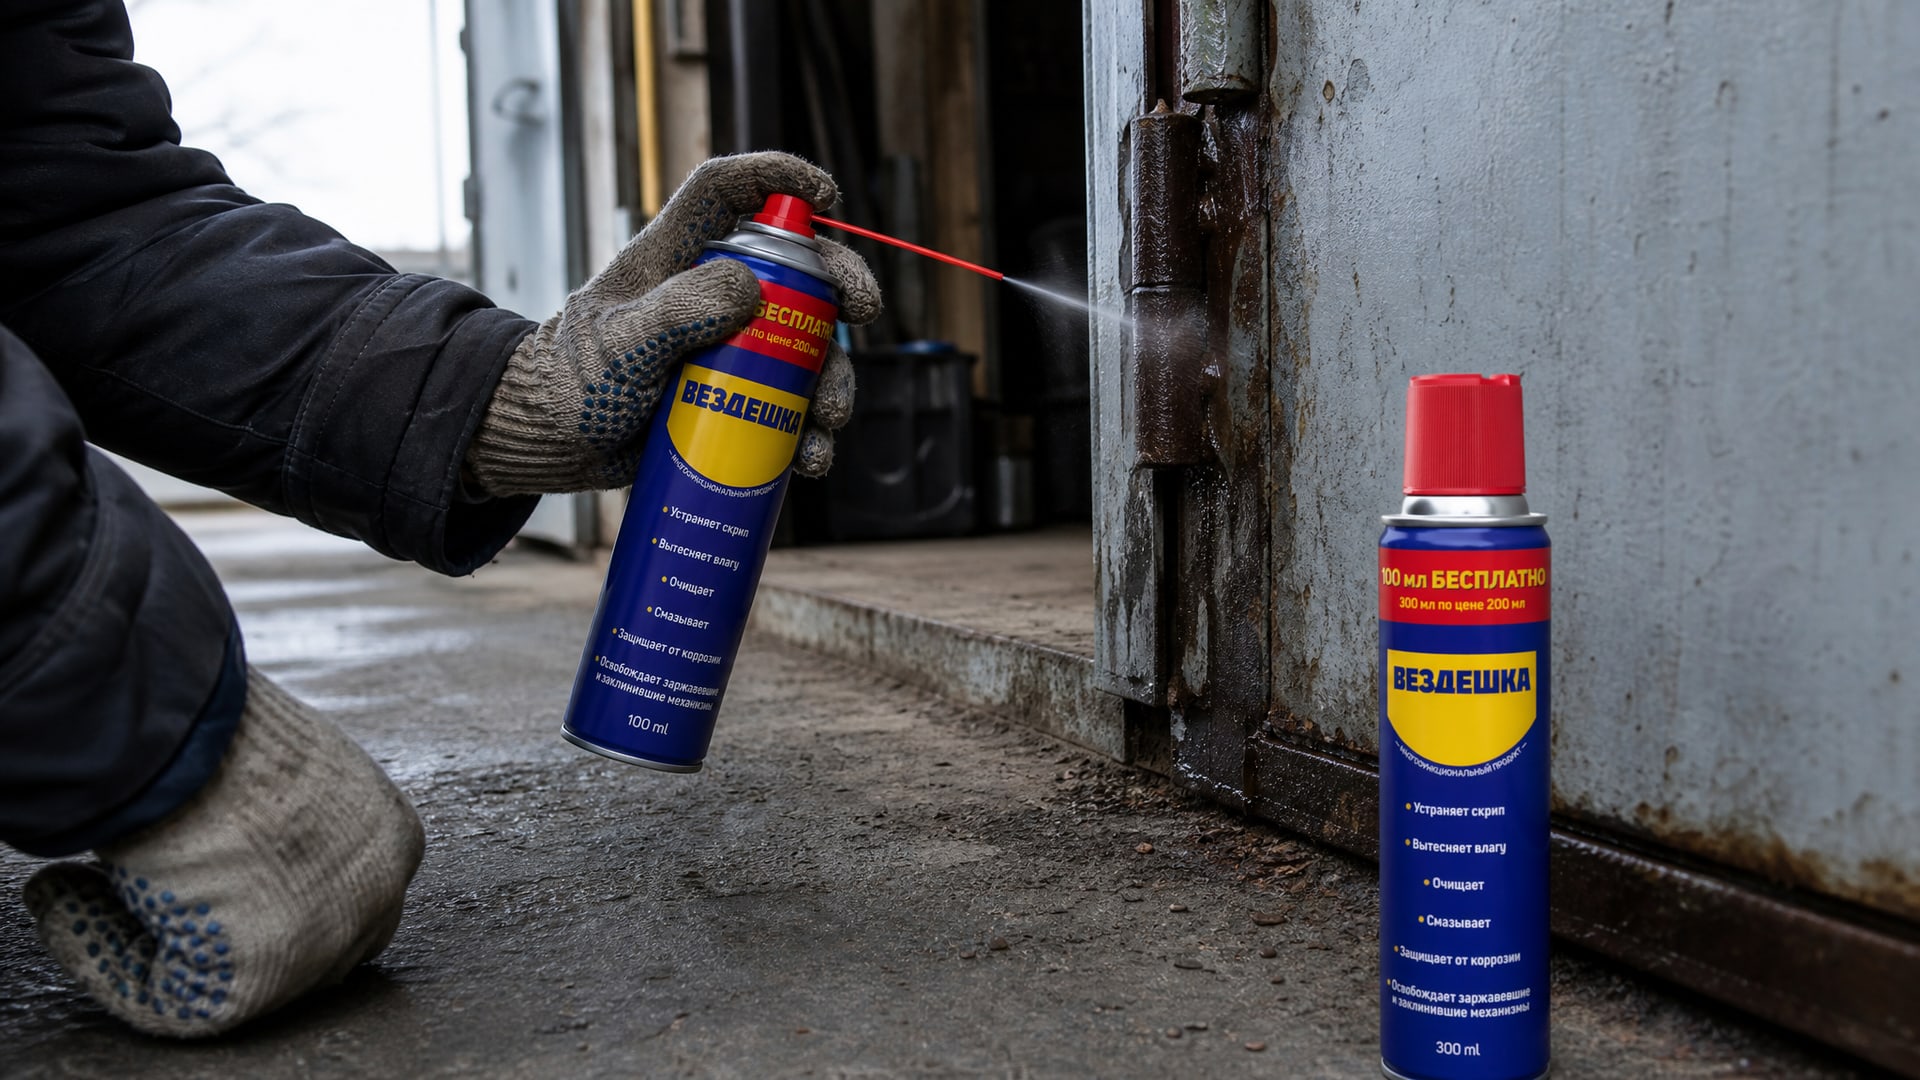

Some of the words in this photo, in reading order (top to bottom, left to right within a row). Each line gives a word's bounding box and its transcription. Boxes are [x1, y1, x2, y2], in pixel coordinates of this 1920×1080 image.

[751, 328, 765, 339] по
[766, 332, 792, 348] цене
[793, 338, 810, 354] 200
[681, 380, 802, 435] ВЕЗДЕШКА
[670, 506, 721, 530] Устраняет
[722, 524, 749, 538] скрип
[658, 538, 712, 562] Вытесняет
[713, 556, 740, 572] влагу
[669, 576, 715, 598] Очищает
[1382, 567, 1401, 587] 100
[1403, 573, 1427, 588] мл
[1431, 567, 1546, 590] БЕСПЛАТНО
[1399, 596, 1418, 609] 300
[1420, 599, 1436, 610] мл
[1438, 600, 1453, 610] по
[1455, 600, 1485, 612] цене
[1486, 598, 1510, 610] 200
[1511, 598, 1526, 609] мл
[654, 606, 710, 630] Смазывает
[618, 628, 667, 653] Защищает
[668, 645, 681, 656] от
[681, 649, 722, 665] коррозии
[600, 656, 661, 685] Освобождает
[1393, 665, 1531, 695] ВЕЗДЕШКА
[595, 672, 601, 681] и
[600, 674, 666, 702] заклинившие
[628, 714, 651, 731] 100
[652, 722, 669, 736] ml
[1413, 801, 1470, 818] Устраняет
[1471, 805, 1506, 819] скрип
[1412, 837, 1473, 854] Вытесняет
[1474, 842, 1507, 856] влагу
[1432, 876, 1485, 892] Очищает
[1426, 913, 1492, 929] Смазывает
[1399, 944, 1454, 966] Защищает
[1455, 955, 1469, 966] от
[1470, 952, 1522, 969] коррозии
[1391, 978, 1457, 1004] Освобождает
[1458, 986, 1532, 1007] заржавевшие
[1392, 994, 1398, 1005] и
[1398, 996, 1468, 1018] заклинившие
[1470, 1001, 1531, 1019] механизмы
[1435, 1040, 1462, 1057] 300
[1463, 1043, 1481, 1057] ml
